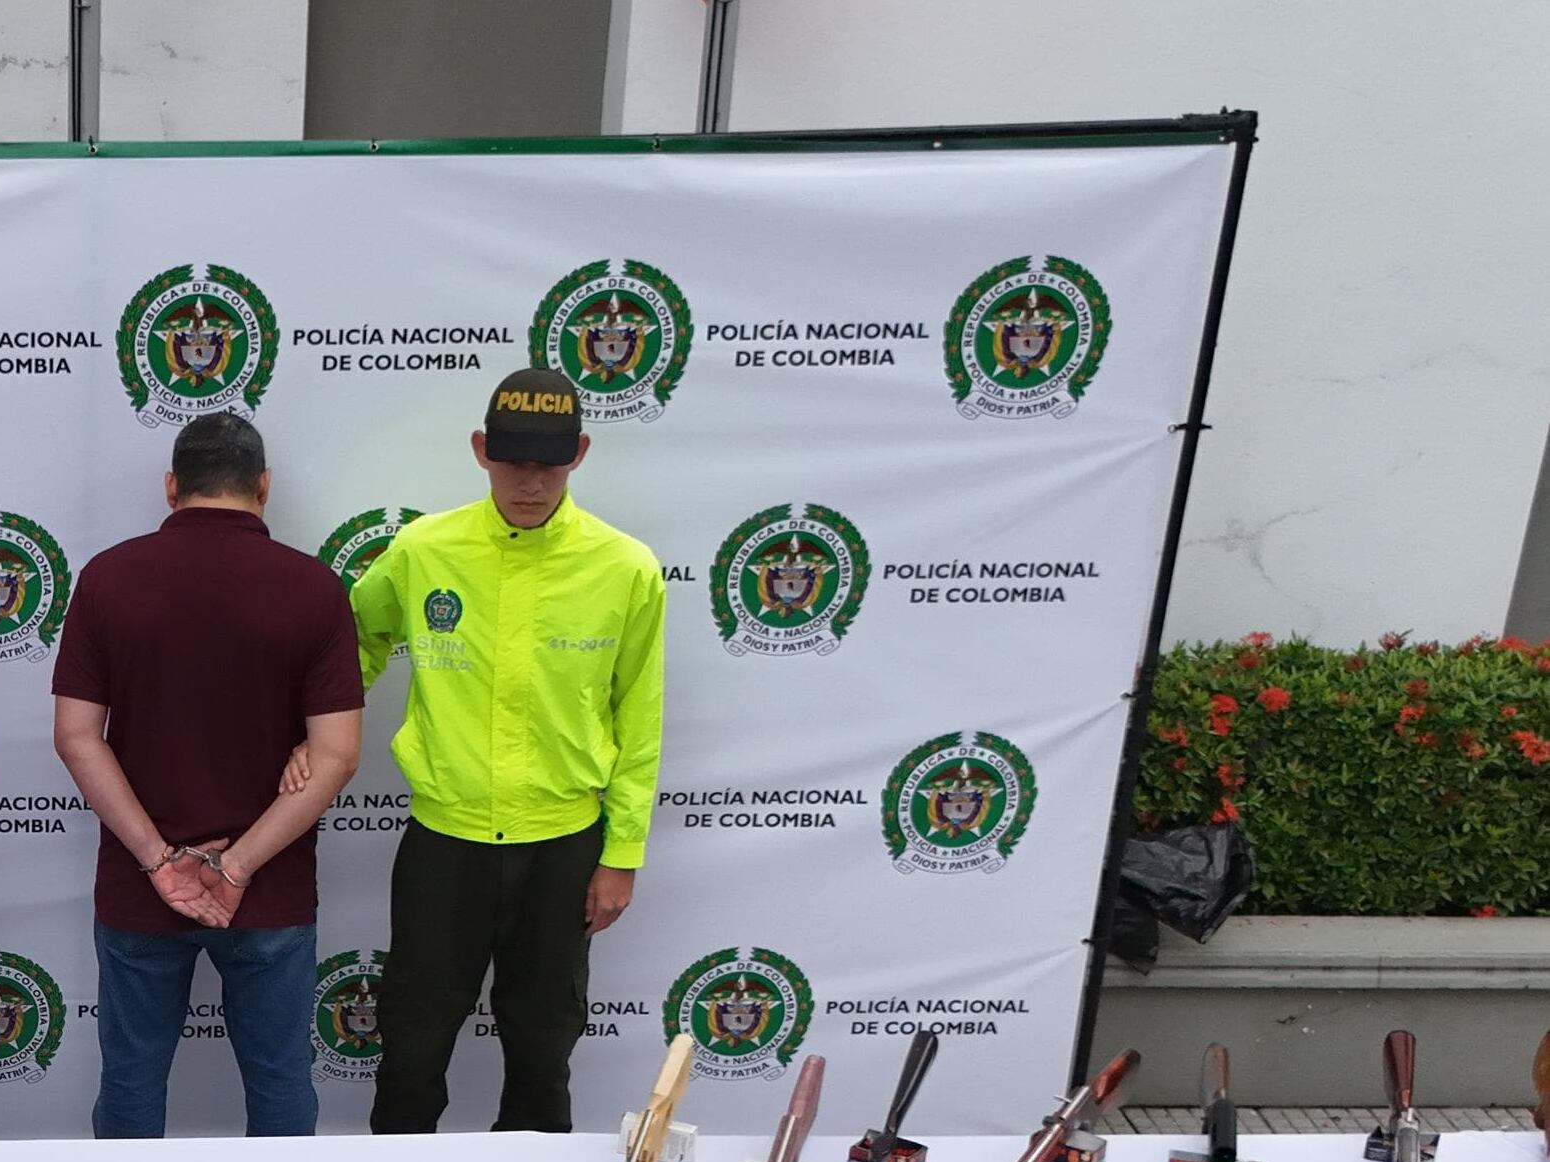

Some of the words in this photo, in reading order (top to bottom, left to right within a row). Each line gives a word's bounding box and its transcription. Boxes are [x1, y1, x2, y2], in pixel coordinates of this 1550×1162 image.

[191, 283, 210, 293] DE
[222, 289, 260, 356] COLOMBIA
[607, 278, 627, 289] DE
[638, 284, 674, 351] COLOMBIA
[1026, 273, 1046, 284] DE
[1057, 280, 1091, 346] COLOMBIA
[293, 324, 384, 346] POLICÍA
[391, 327, 514, 345] NACIONAL
[707, 319, 799, 341] POLICÍA
[806, 322, 929, 340] NACIONAL
[322, 355, 352, 371] DE
[358, 353, 481, 371] COLOMBIA
[735, 350, 765, 367] DE
[772, 349, 895, 367] COLOMBIA
[197, 369, 253, 409] NACIONAL
[606, 364, 665, 404] NACIONAL
[1019, 360, 1080, 400] NACIONAL
[496, 391, 574, 415] POLICIA
[603, 400, 647, 420] PATRIA
[1015, 396, 1060, 416] PATRIA
[15, 534, 53, 597] COLOMBIA
[787, 520, 807, 531] DE
[818, 526, 852, 589] COLOMBIA
[883, 560, 973, 580] POLICÍA
[979, 562, 1099, 579] NACIONAL
[910, 588, 940, 604] DE
[945, 587, 1065, 603] COLOMBIA
[784, 601, 842, 638] NACIONAL
[781, 634, 824, 653] PATRIA
[957, 747, 977, 757] DE
[987, 753, 1018, 811] COLOMBIA
[658, 787, 745, 807] POLICÍA
[751, 790, 868, 805] NACIONAL
[332, 817, 410, 832] COLOM
[684, 813, 713, 828] DE
[719, 813, 836, 828] COLOMBIA
[951, 822, 1008, 857] NACIONAL
[13, 972, 49, 1026] COLOMBIA
[735, 962, 754, 971] DE
[763, 967, 796, 1022] COLOMBIA
[826, 997, 910, 1015] POLICÍA
[916, 999, 1029, 1014] NACIONAL
[851, 1021, 879, 1035] DE
[733, 1032, 787, 1065] NACIONAL
